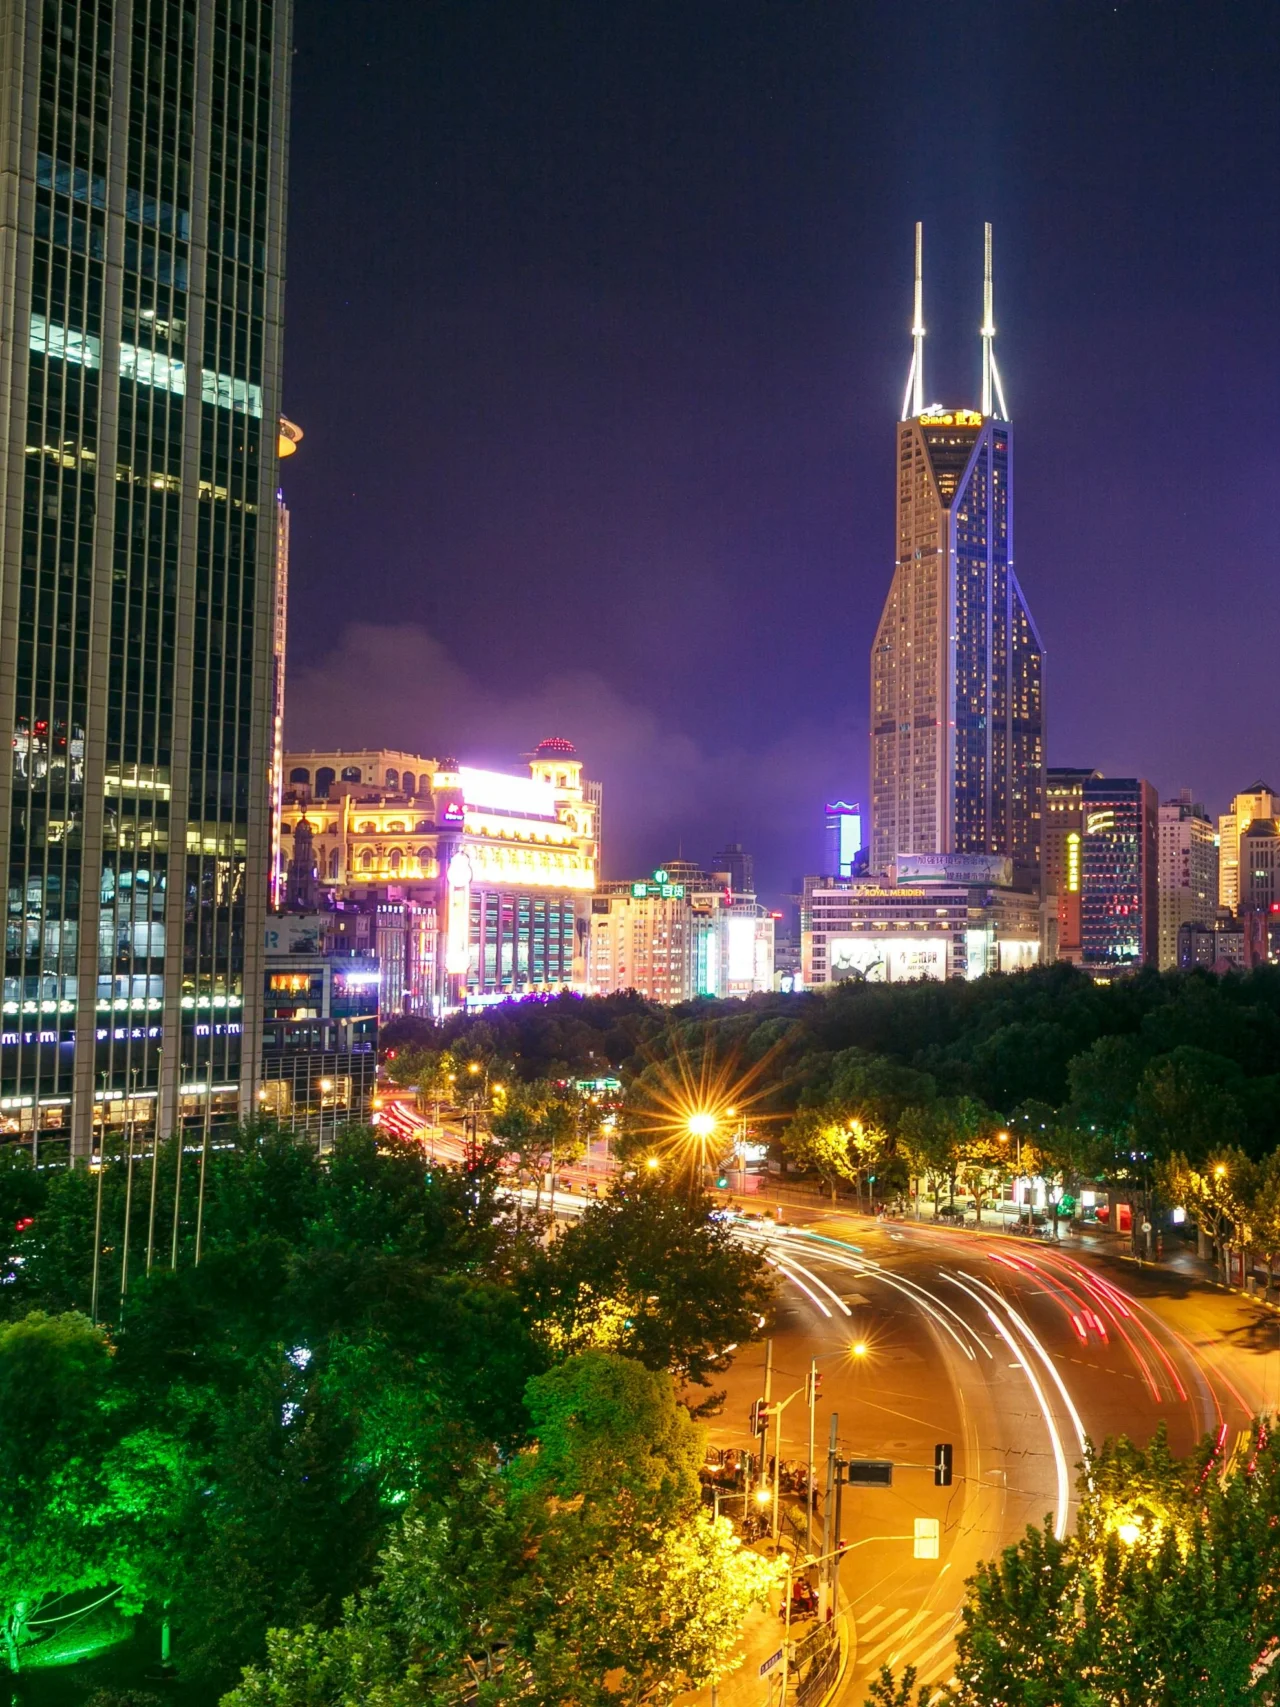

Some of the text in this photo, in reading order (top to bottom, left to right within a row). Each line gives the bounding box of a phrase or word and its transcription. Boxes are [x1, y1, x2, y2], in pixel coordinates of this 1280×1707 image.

[955, 411, 982, 426] 世茂
[633, 884, 684, 898] 第一百货
